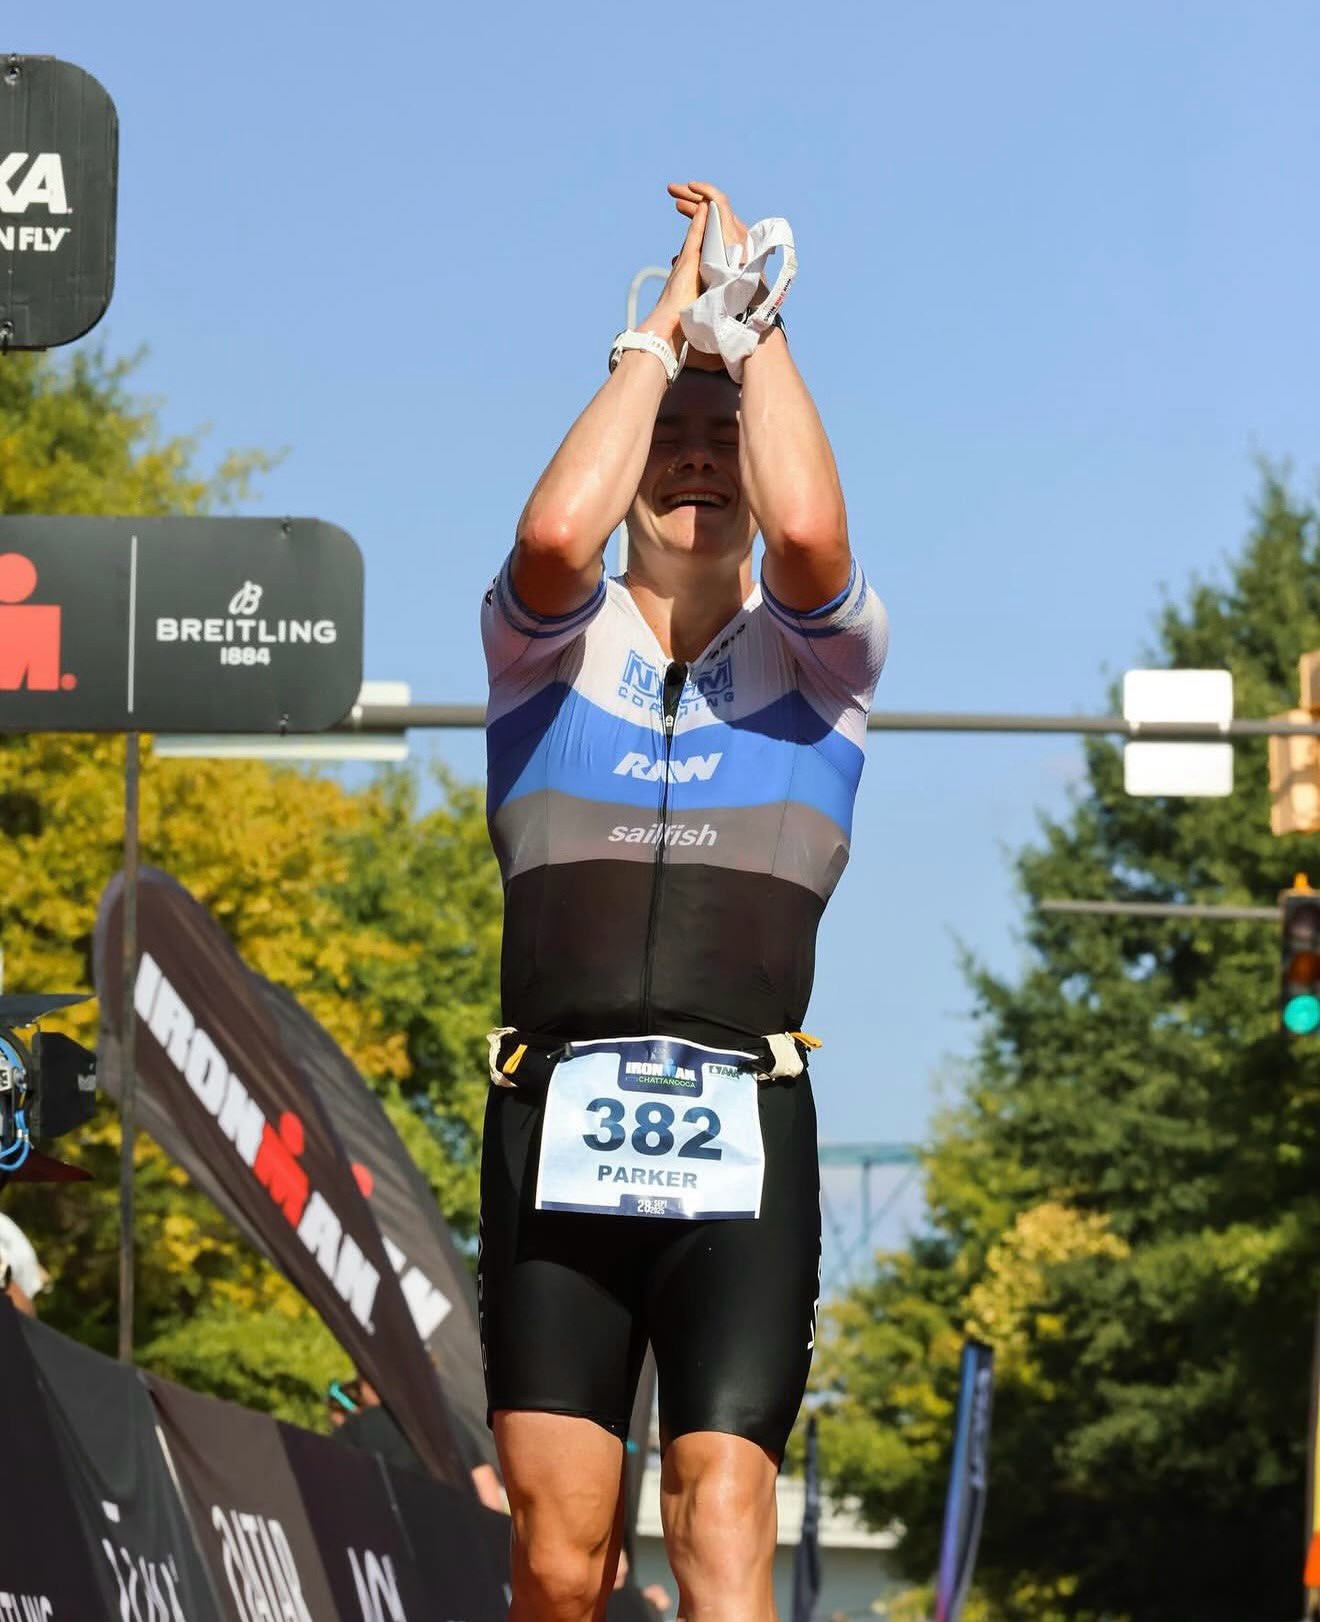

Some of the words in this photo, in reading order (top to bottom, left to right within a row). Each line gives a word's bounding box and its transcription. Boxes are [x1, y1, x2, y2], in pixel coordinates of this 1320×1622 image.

[19, 226, 67, 251] FLY
[156, 617, 337, 644] BREITLING
[220, 647, 271, 666] 1884
[613, 752, 723, 784] RAW
[608, 823, 718, 848] sailfish
[625, 1058, 697, 1082] IRONMAN
[638, 1075, 696, 1089] CHATTANOOGA
[133, 951, 380, 1328] IRONMAN
[582, 1097, 722, 1161] 382
[598, 1165, 698, 1189] PARKER
